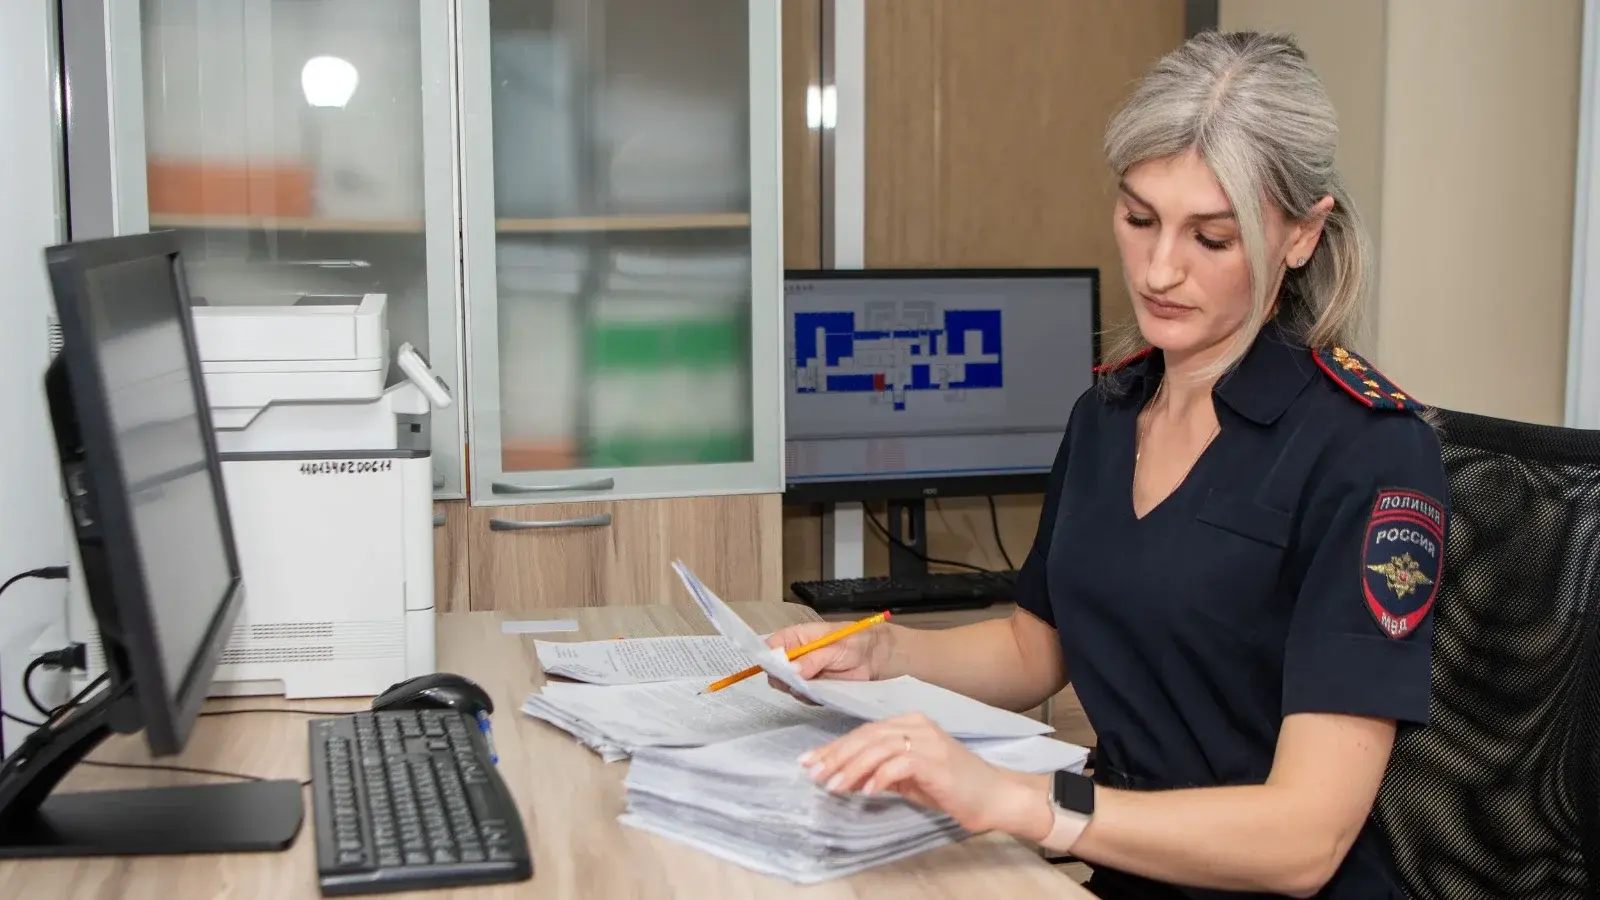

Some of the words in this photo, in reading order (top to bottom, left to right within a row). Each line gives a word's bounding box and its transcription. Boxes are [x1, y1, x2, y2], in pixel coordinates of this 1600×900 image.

[1380, 496, 1441, 525] ПОЛИЦИЯ
[1376, 528, 1435, 558] РОССИЯ
[1381, 612, 1408, 635] МВД
